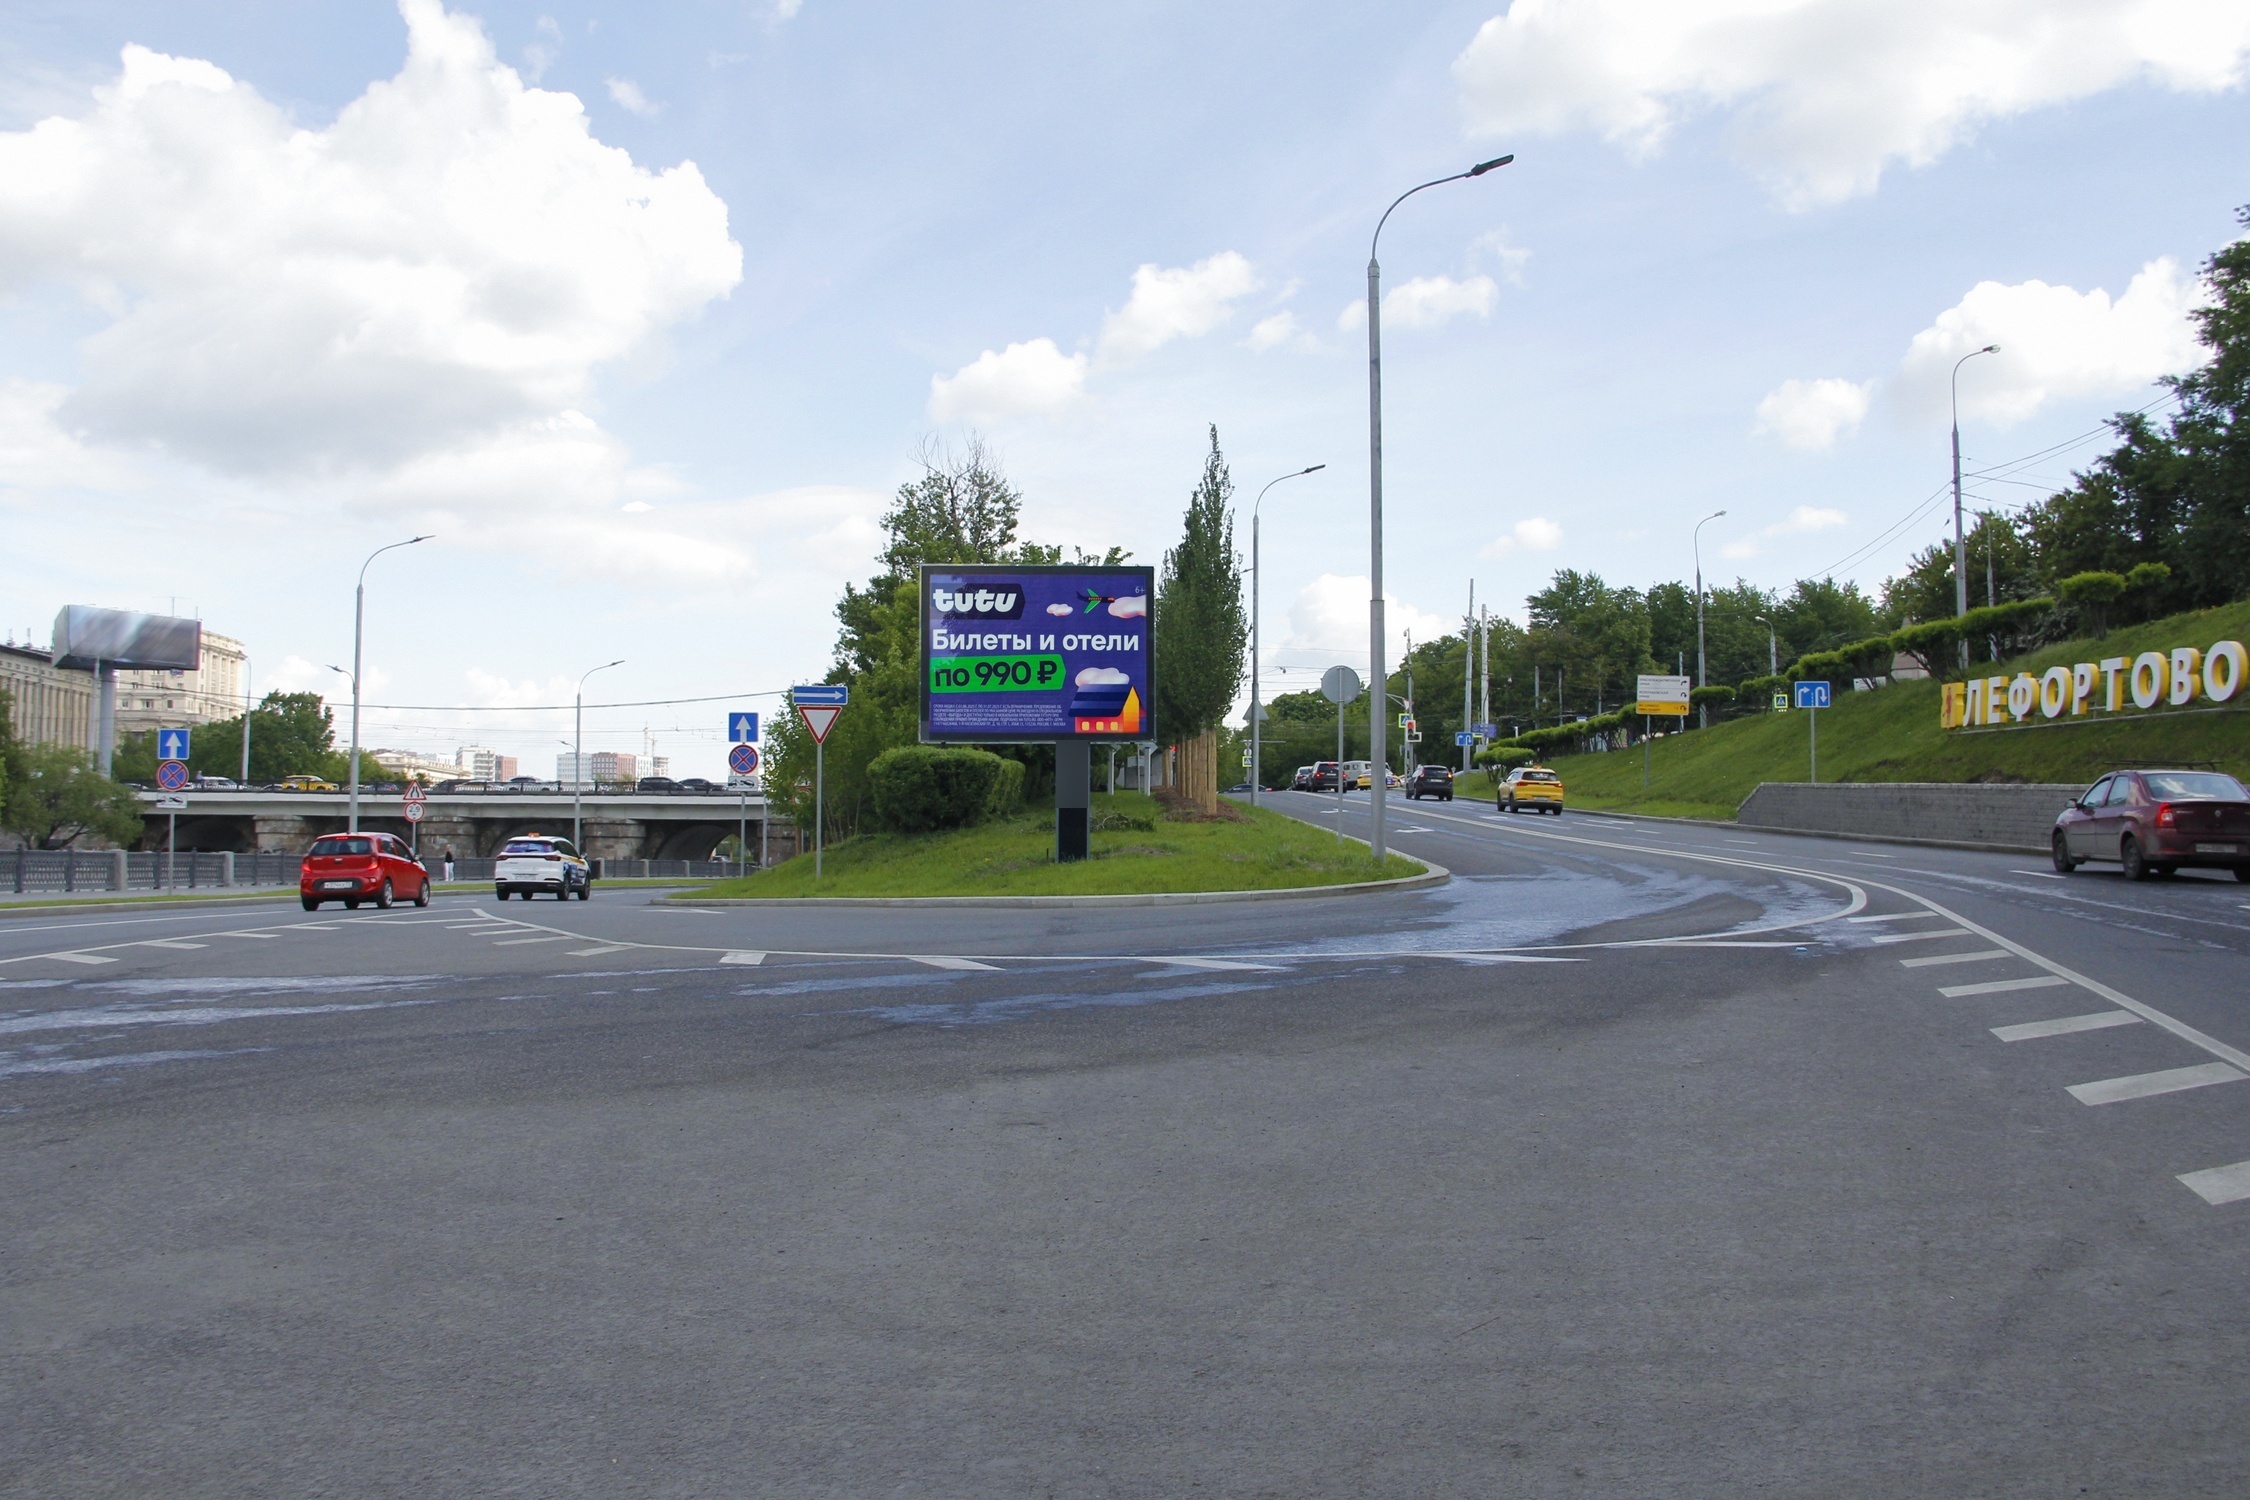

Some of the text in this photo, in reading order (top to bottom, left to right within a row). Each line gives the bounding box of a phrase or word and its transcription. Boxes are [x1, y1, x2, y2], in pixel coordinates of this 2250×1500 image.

[933, 589, 1017, 612] tutu
[1135, 586, 1145, 594] 6+
[932, 629, 1139, 651] Билеты и отели
[935, 668, 970, 687] по
[974, 661, 1031, 686] 990
[1962, 640, 2249, 727] ЛЕФОРТОВО
